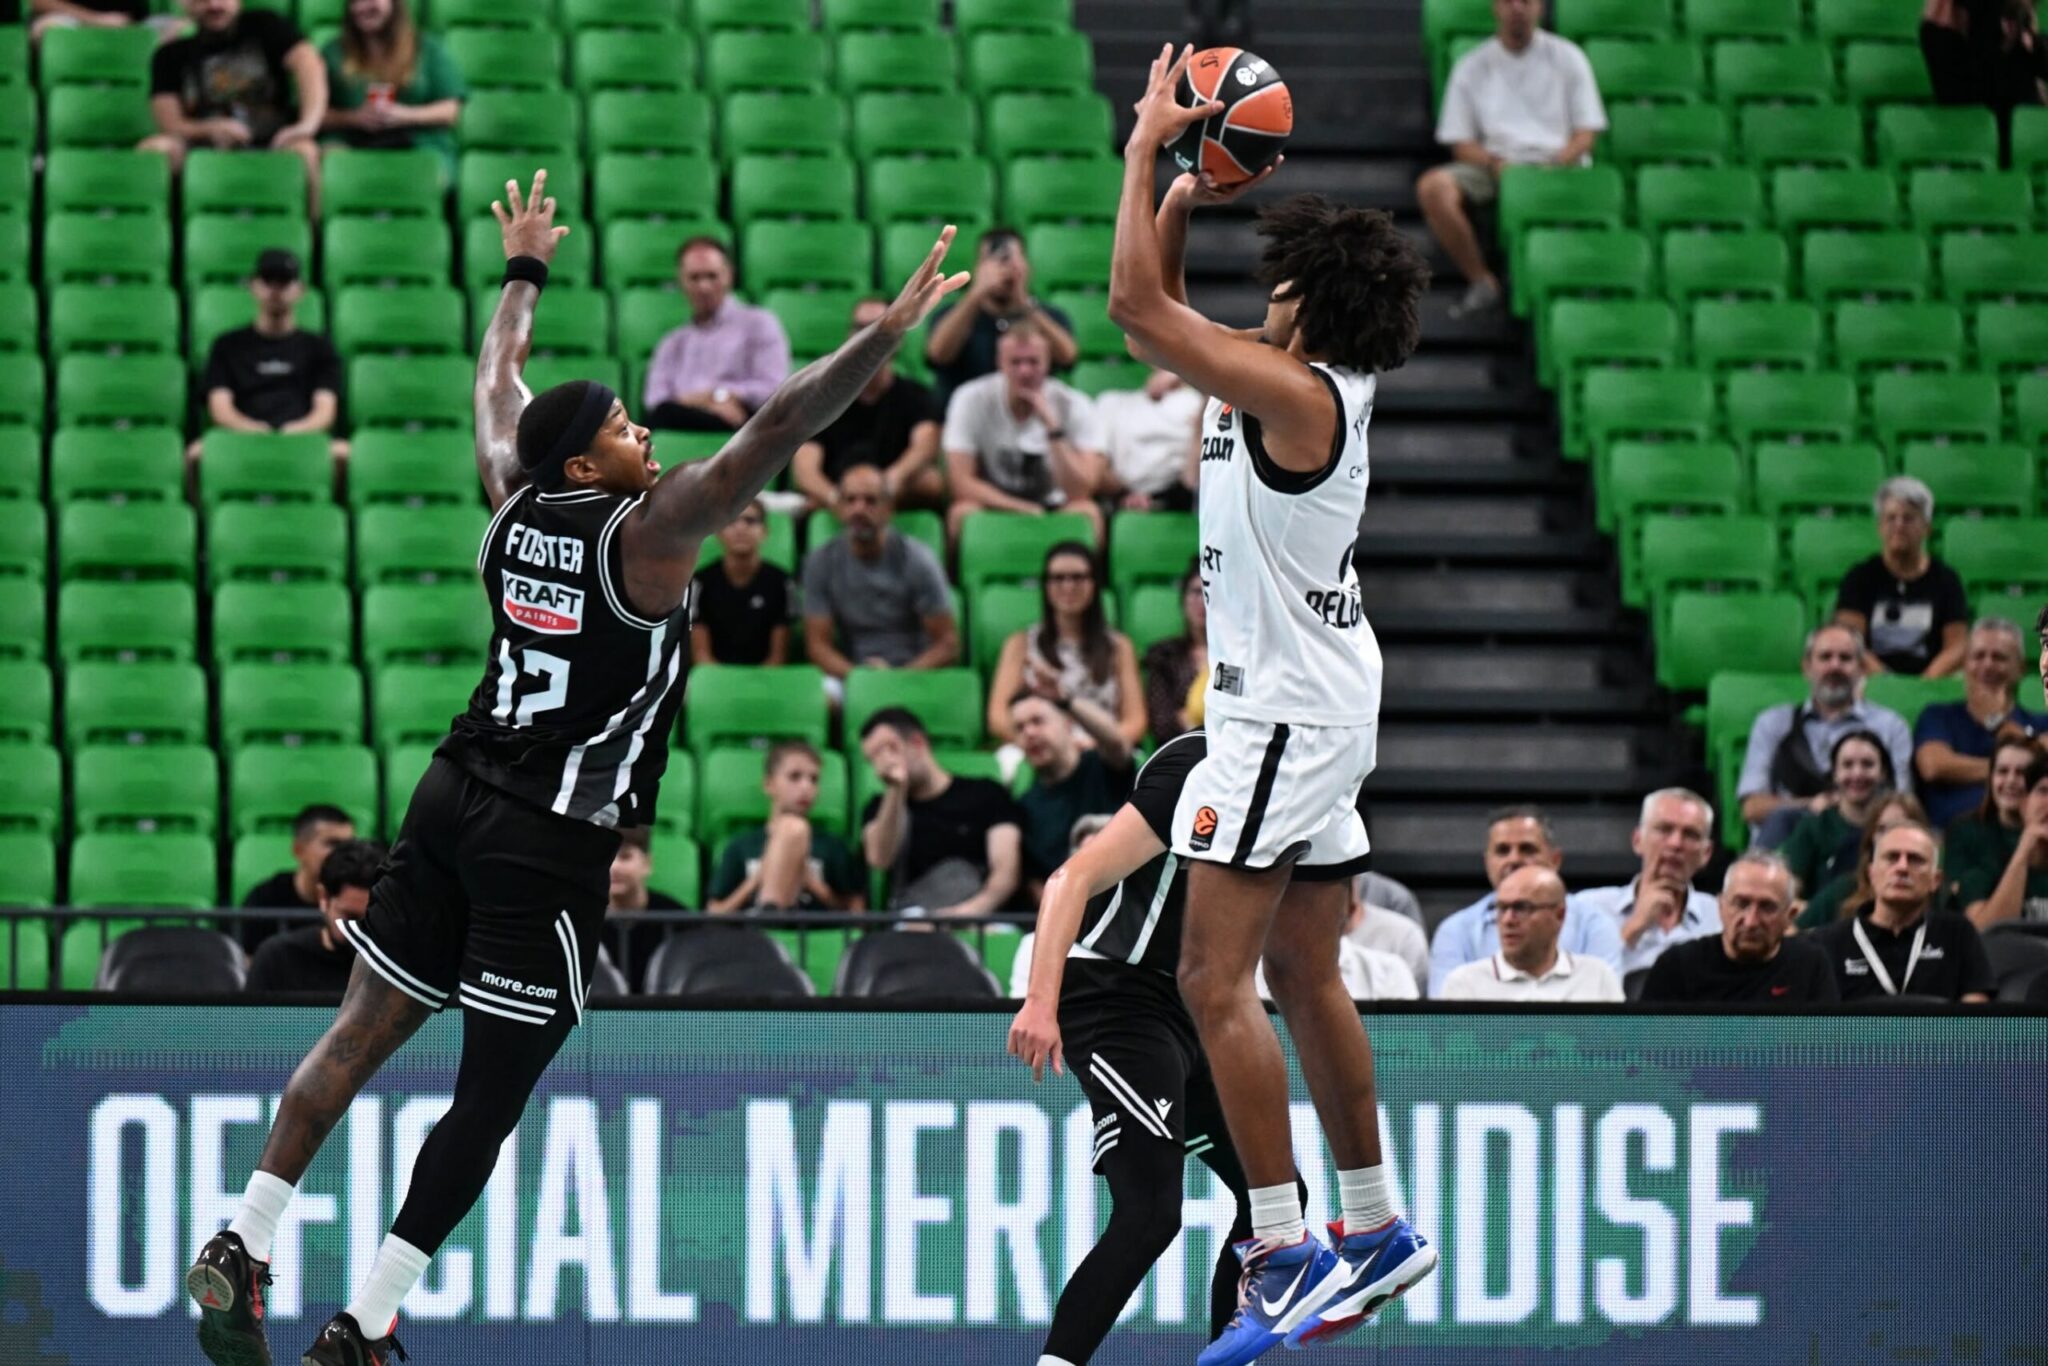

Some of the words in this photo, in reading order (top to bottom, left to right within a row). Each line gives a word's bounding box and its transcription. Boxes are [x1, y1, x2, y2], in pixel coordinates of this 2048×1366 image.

[505, 522, 584, 575] FOSTER
[503, 574, 581, 614] KRAFT
[516, 608, 558, 627] PAINTS
[491, 638, 571, 729] 12
[481, 971, 558, 999] more.com
[87, 1094, 698, 1322] OFFICIAL
